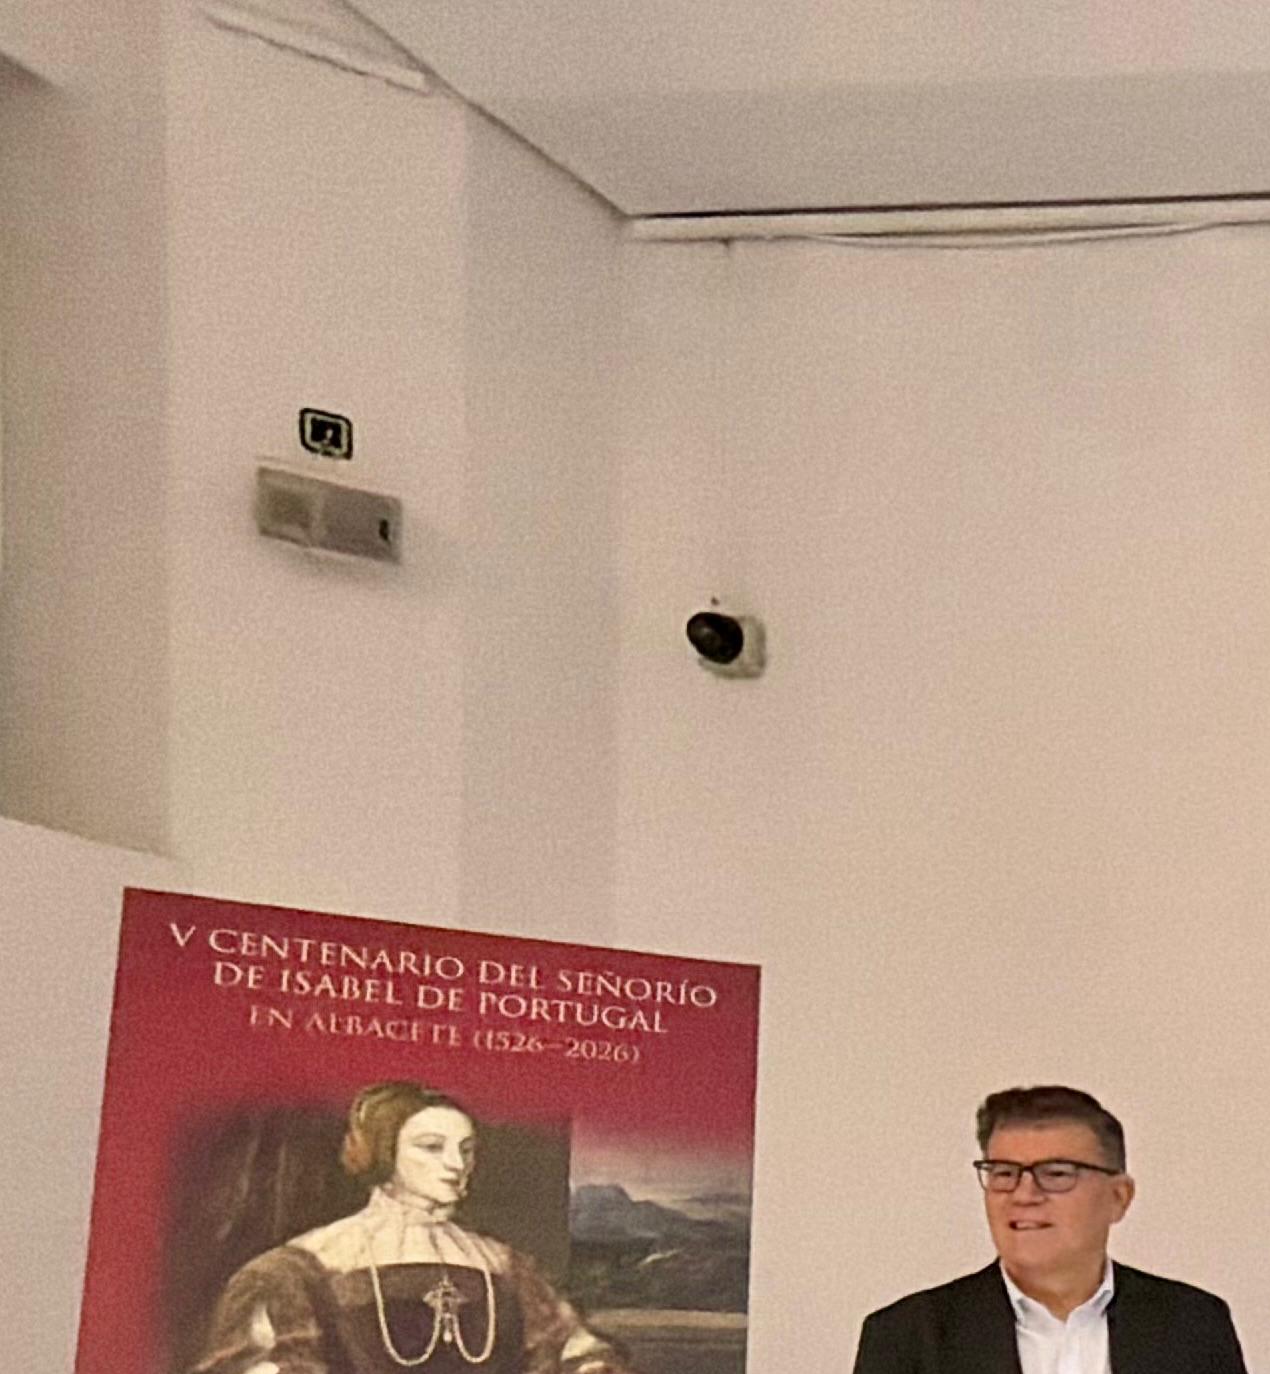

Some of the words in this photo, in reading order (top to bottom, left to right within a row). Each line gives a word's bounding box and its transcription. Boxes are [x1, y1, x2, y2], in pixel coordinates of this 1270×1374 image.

[169, 922, 196, 947] V
[208, 928, 465, 980] CENTENARIO
[478, 960, 544, 989] DEL
[556, 968, 718, 1008] SEÑORÍO
[213, 961, 264, 989] DE
[279, 969, 403, 1005] ISABEL
[416, 985, 465, 1012] DE
[478, 991, 669, 1033] PORTUGAL
[250, 1004, 293, 1029] EN
[306, 1011, 462, 1046] ALBACETE
